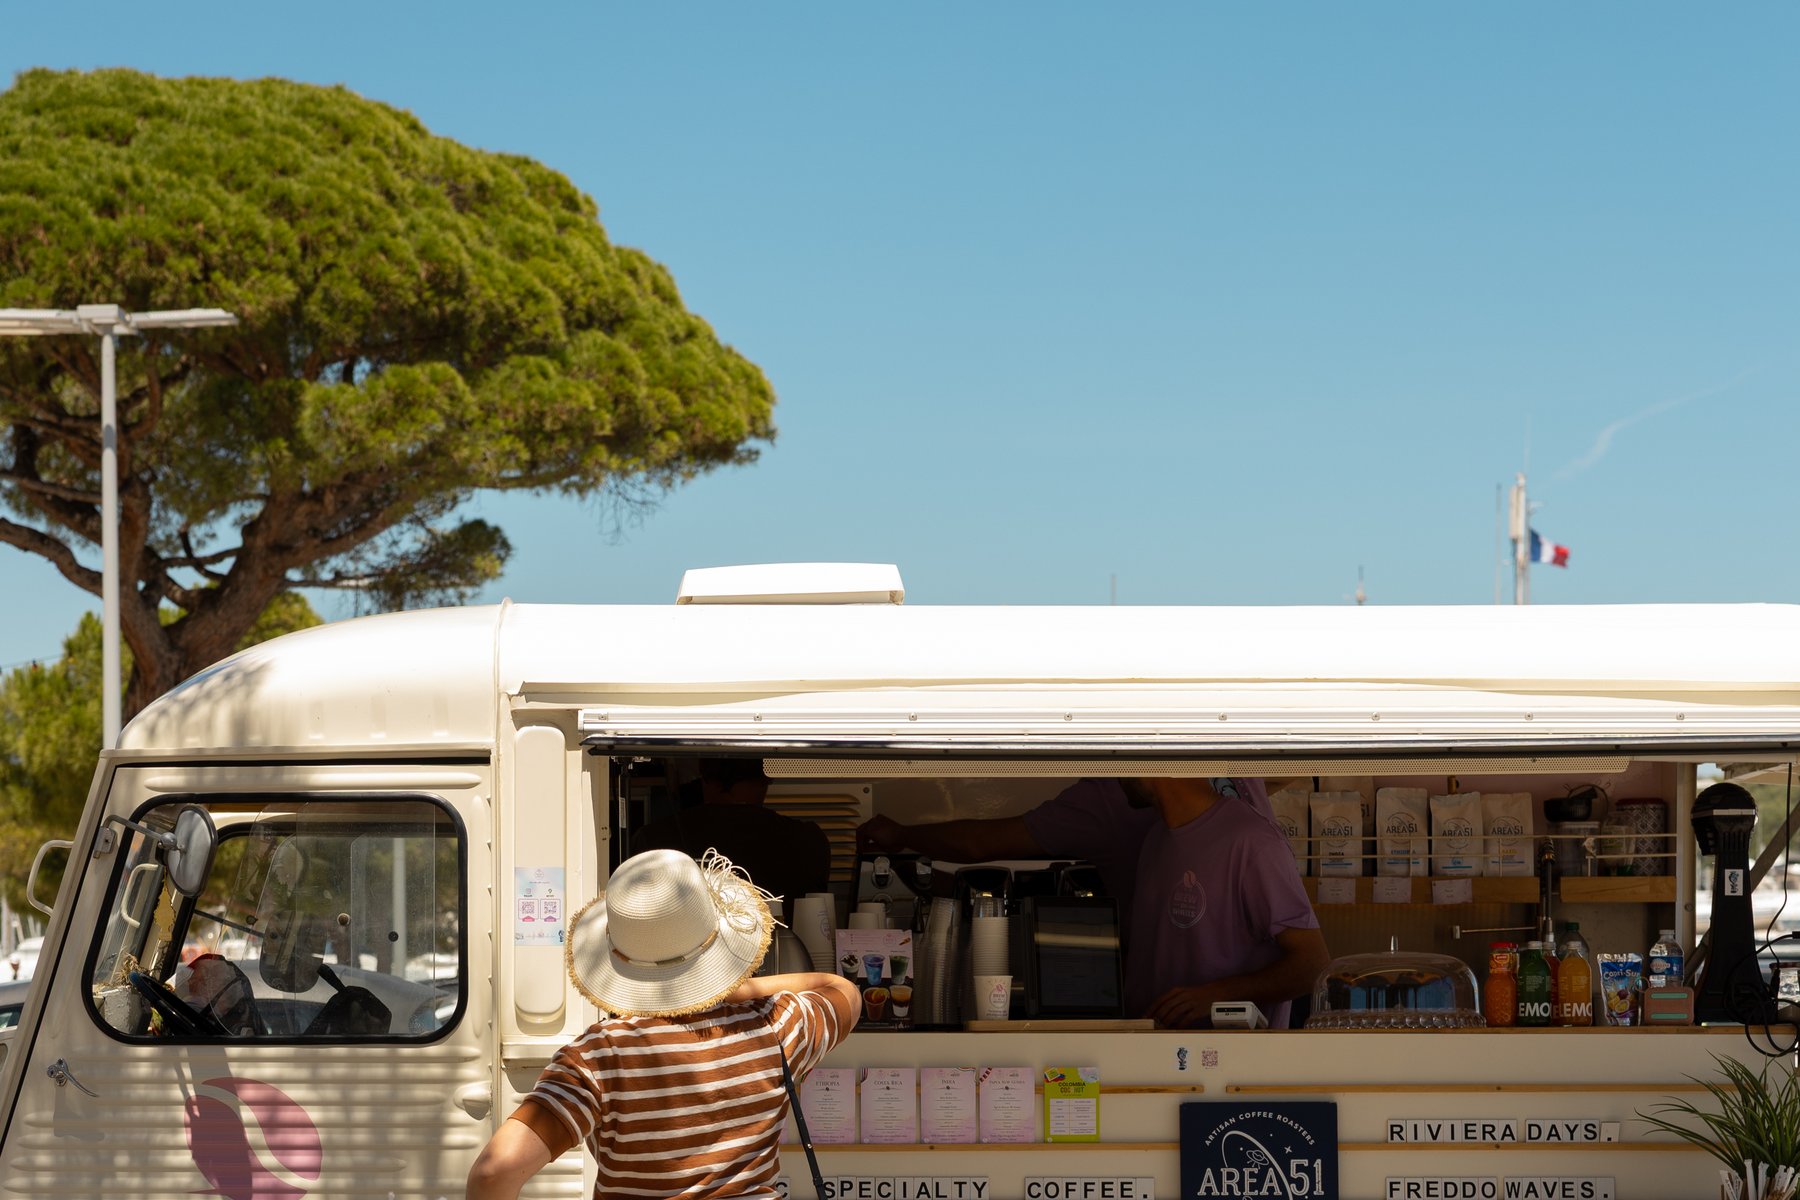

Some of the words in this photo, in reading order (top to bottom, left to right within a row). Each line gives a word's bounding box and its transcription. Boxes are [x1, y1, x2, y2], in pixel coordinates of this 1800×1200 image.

[1321, 827, 1342, 836] AREA
[1343, 826, 1353, 836] 51
[1386, 826, 1407, 834] AREA
[1408, 823, 1418, 833] 51
[1464, 827, 1473, 836] 51
[1491, 827, 1512, 835] AREA
[1514, 826, 1524, 835] 51
[1204, 1117, 1236, 1147] ARTISAN
[1239, 1111, 1273, 1120] COFFEE
[1276, 1114, 1316, 1146] ROASTERS
[1390, 1123, 1516, 1141] RIVIERA
[1528, 1123, 1612, 1142] DAYS.
[1197, 1167, 1283, 1196] AREA
[1290, 1158, 1325, 1196] 51
[823, 1180, 988, 1199] SPECIALTY
[1027, 1181, 1148, 1199] COFFEE.
[1389, 1181, 1497, 1199] FREDDO
[1506, 1181, 1609, 1199] WAVES.
